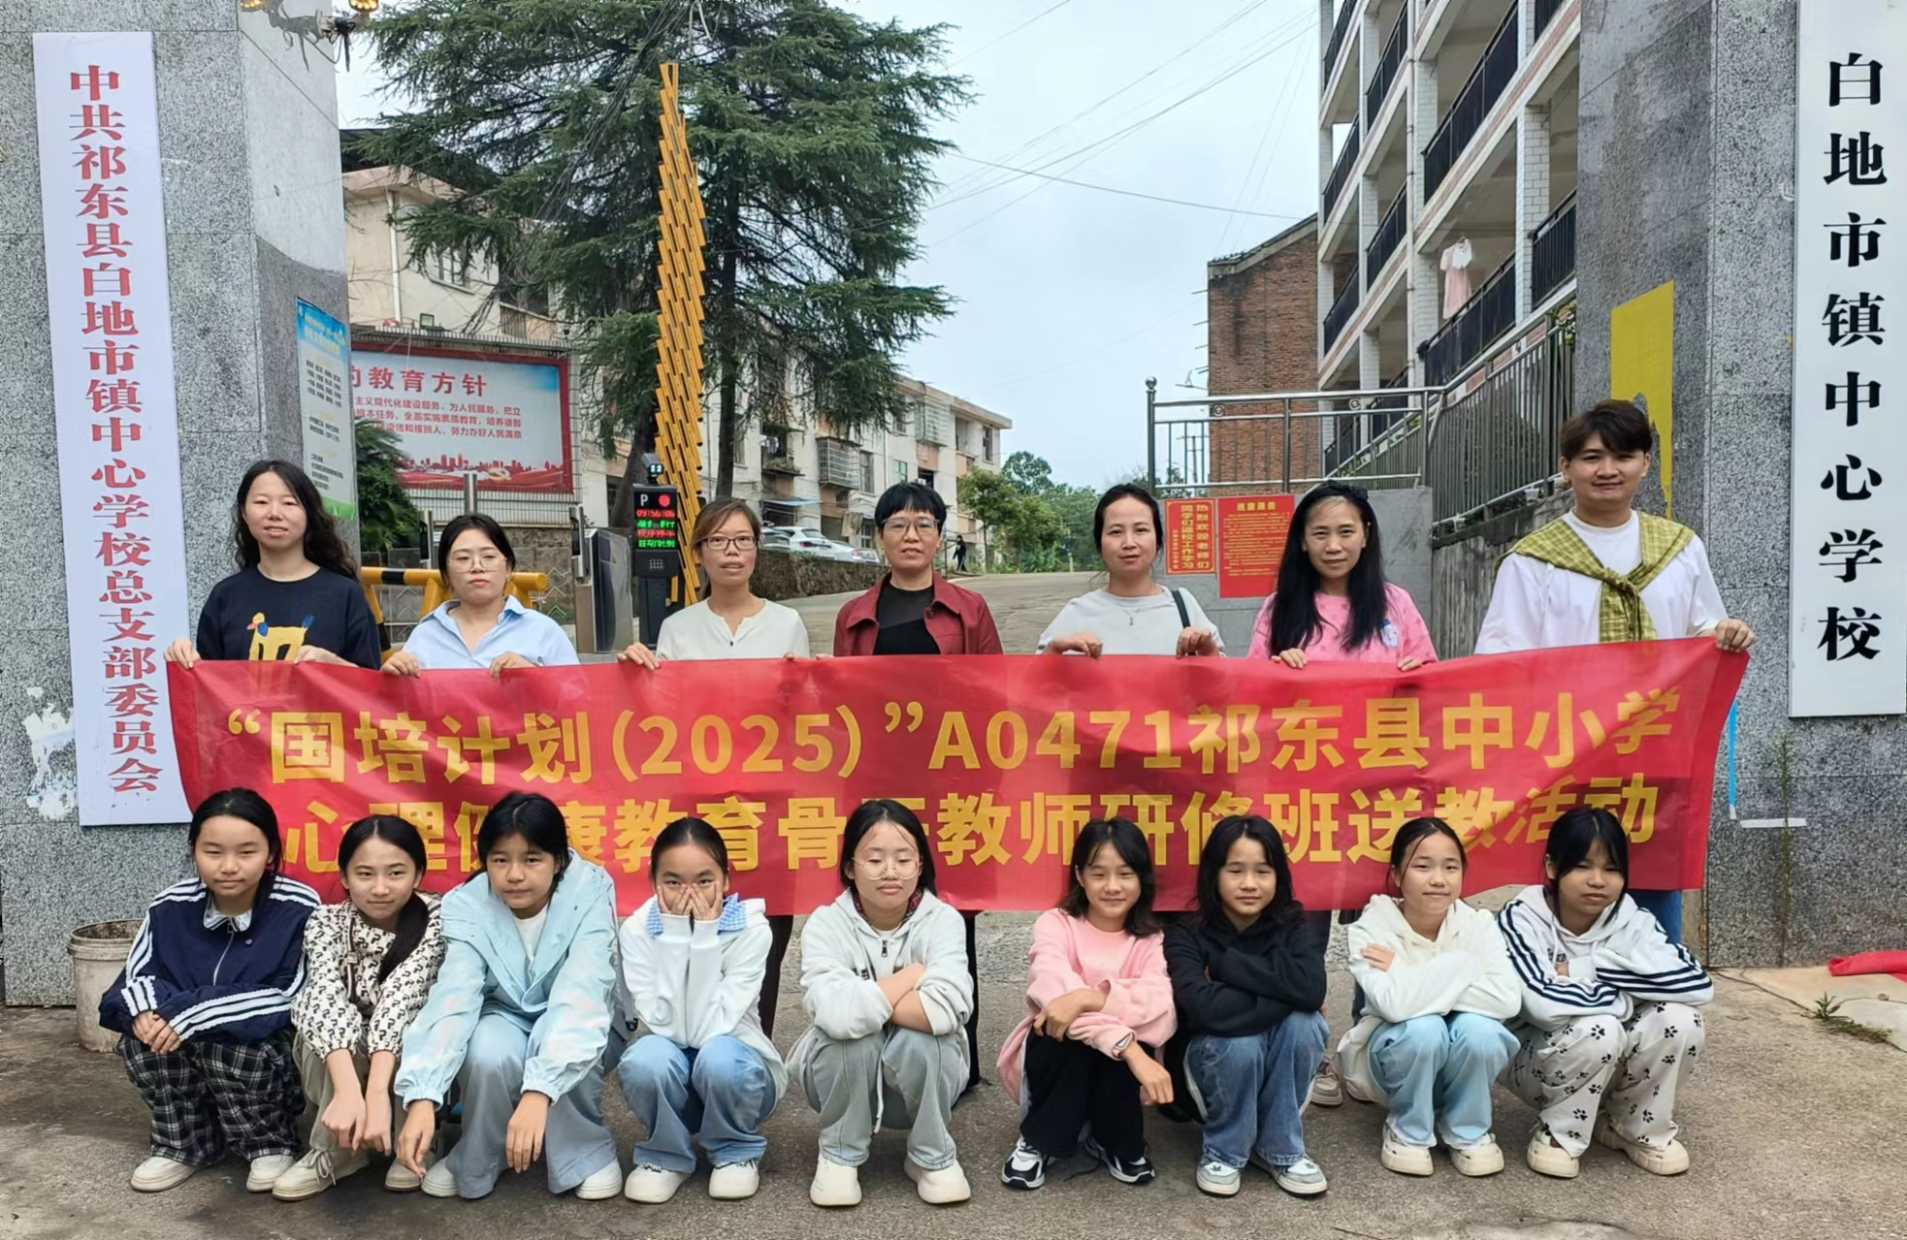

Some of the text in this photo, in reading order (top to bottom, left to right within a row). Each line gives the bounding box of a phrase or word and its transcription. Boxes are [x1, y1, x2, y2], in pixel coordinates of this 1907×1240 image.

[69, 64, 162, 792] 中共祁东县白地市镇中心学校总支部委员会
[640, 493, 648, 506] P
[1817, 52, 1888, 661] 白地市镇中心学校
